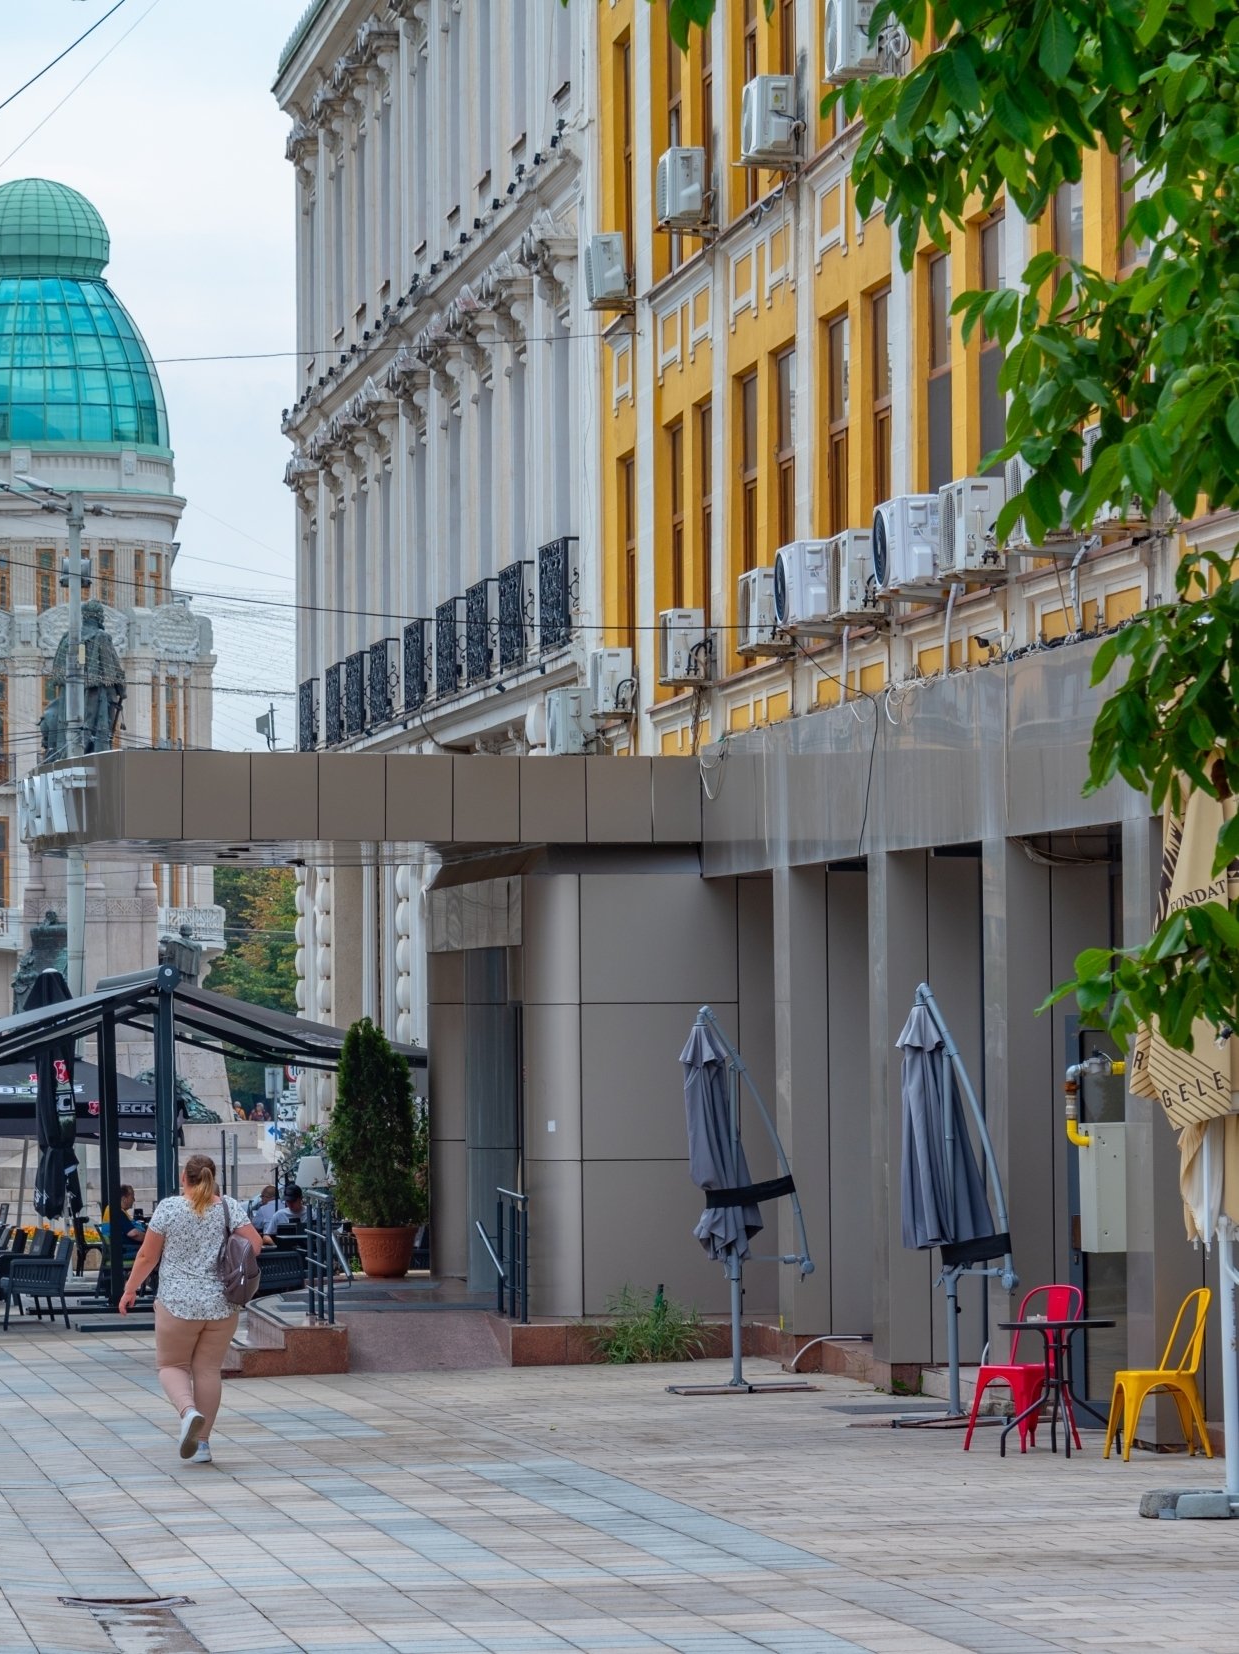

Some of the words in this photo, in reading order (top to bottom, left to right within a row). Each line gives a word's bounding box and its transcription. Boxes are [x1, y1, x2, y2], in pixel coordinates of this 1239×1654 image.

[1170, 880, 1226, 913] FONDAT
[1162, 1071, 1224, 1108] GELE
[117, 1103, 155, 1113] ECK
